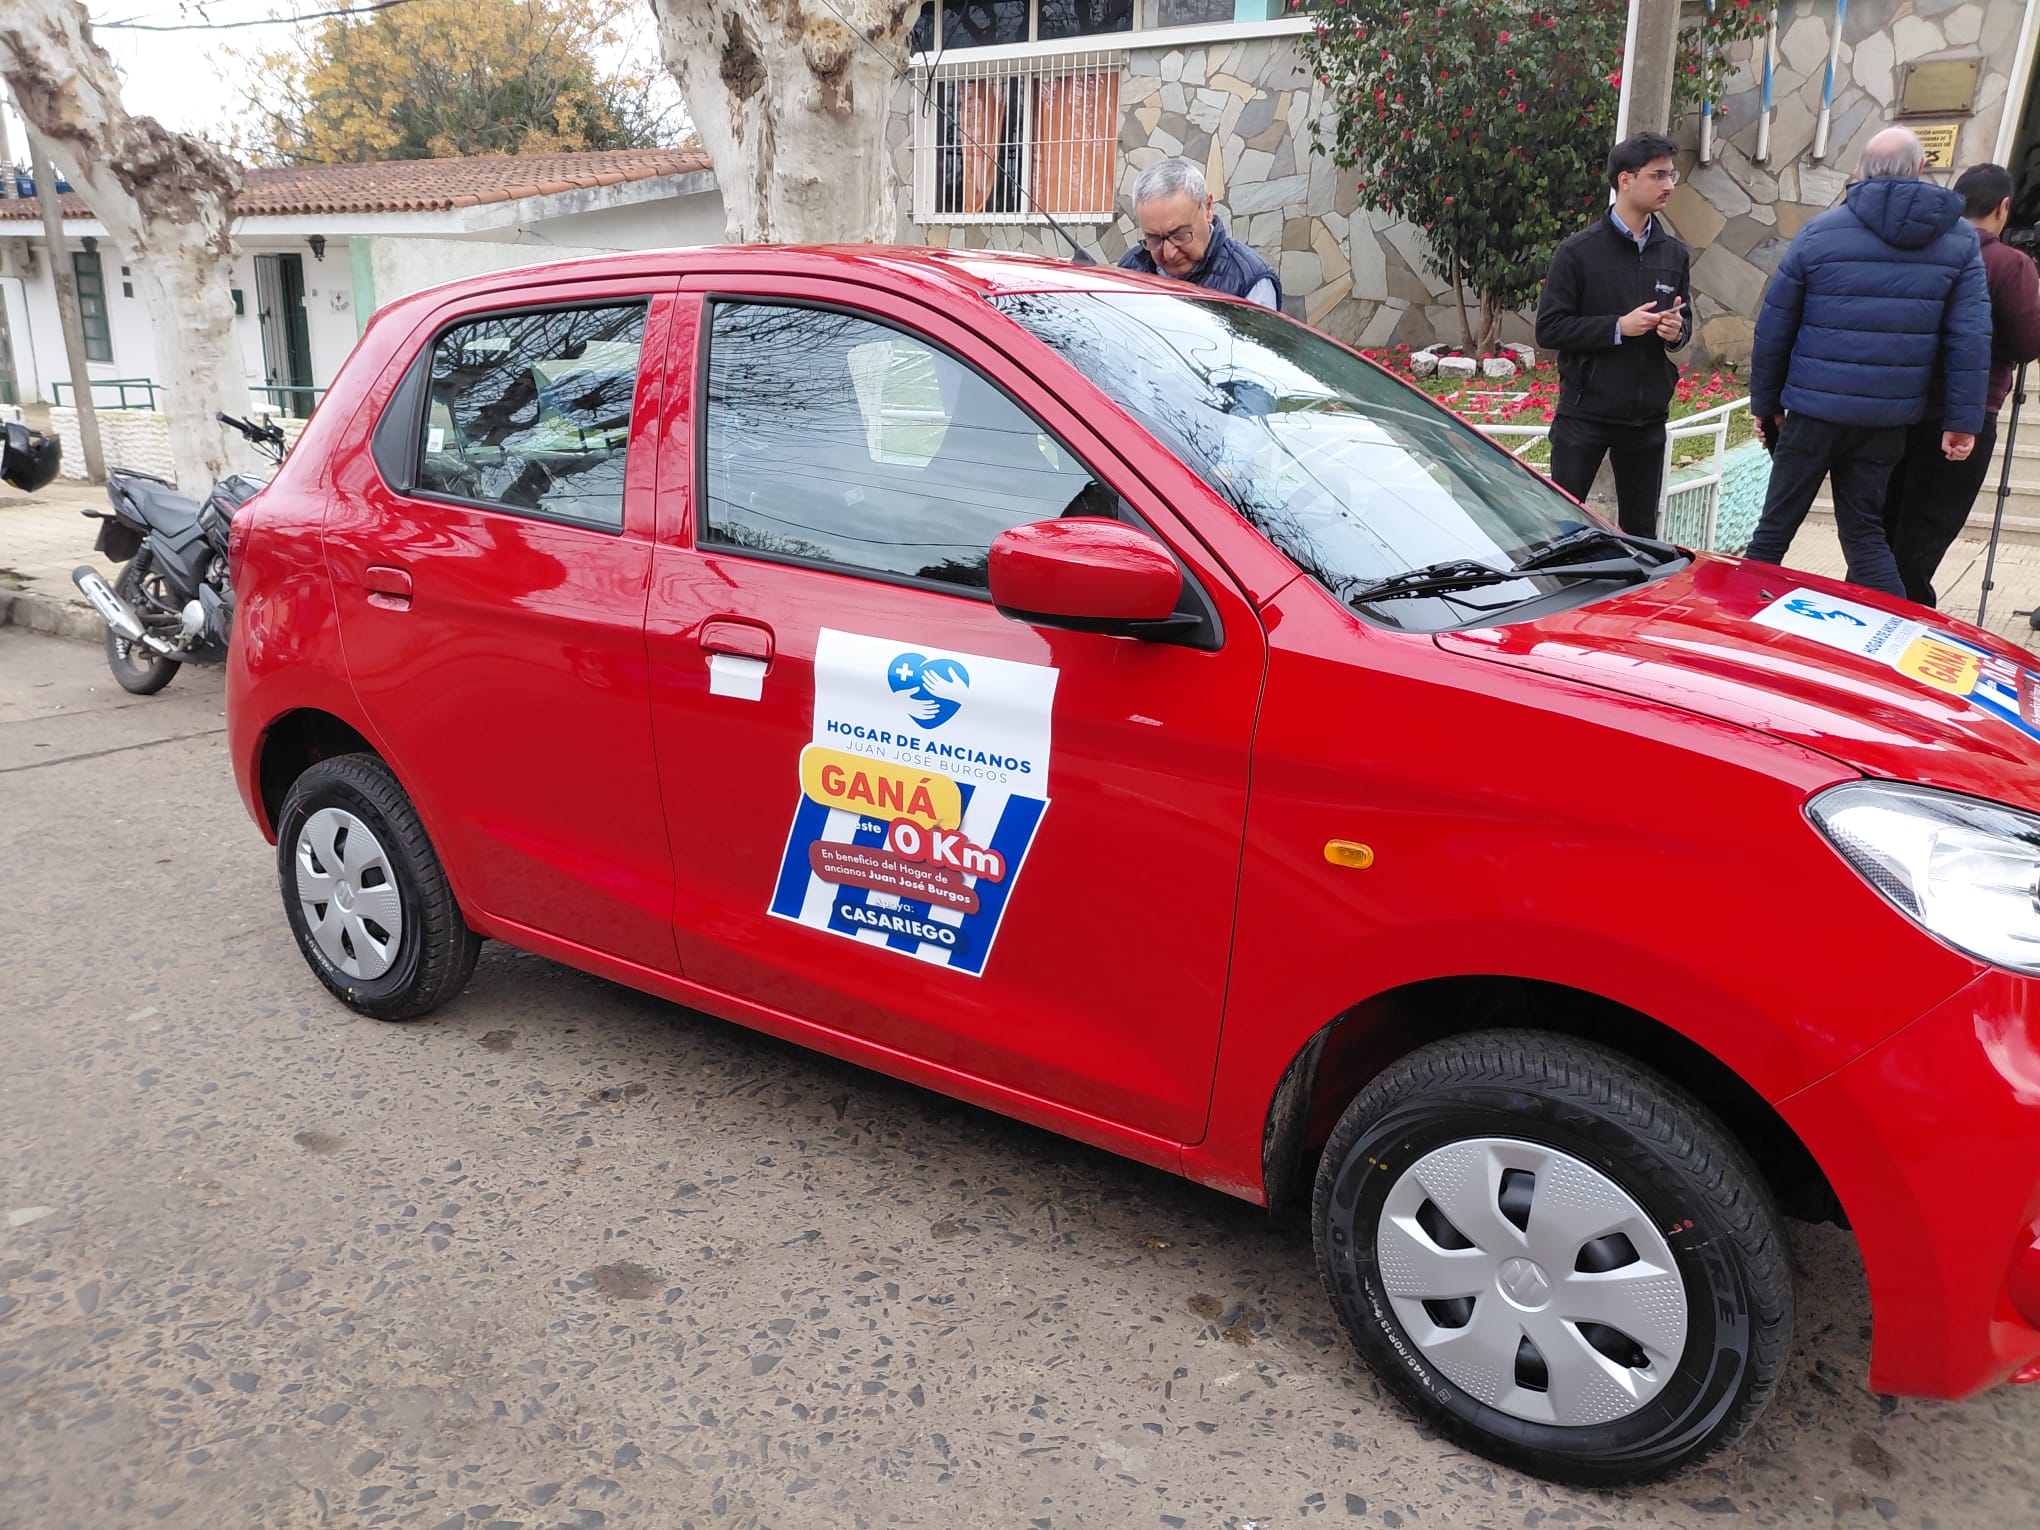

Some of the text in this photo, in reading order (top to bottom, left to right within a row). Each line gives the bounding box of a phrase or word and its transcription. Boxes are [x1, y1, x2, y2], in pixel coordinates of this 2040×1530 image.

[827, 720, 1032, 774] HOGAR DE ANCIANOS
[846, 740, 1008, 783] JUAN JOSÉ BURGOS
[821, 764, 937, 820] GANÁ
[821, 849, 948, 884] En beneficio del Hogar de
[933, 831, 999, 876] Km
[824, 865, 971, 904] ancianos Juan José Burgos
[841, 905, 956, 944] CASARIEGO
